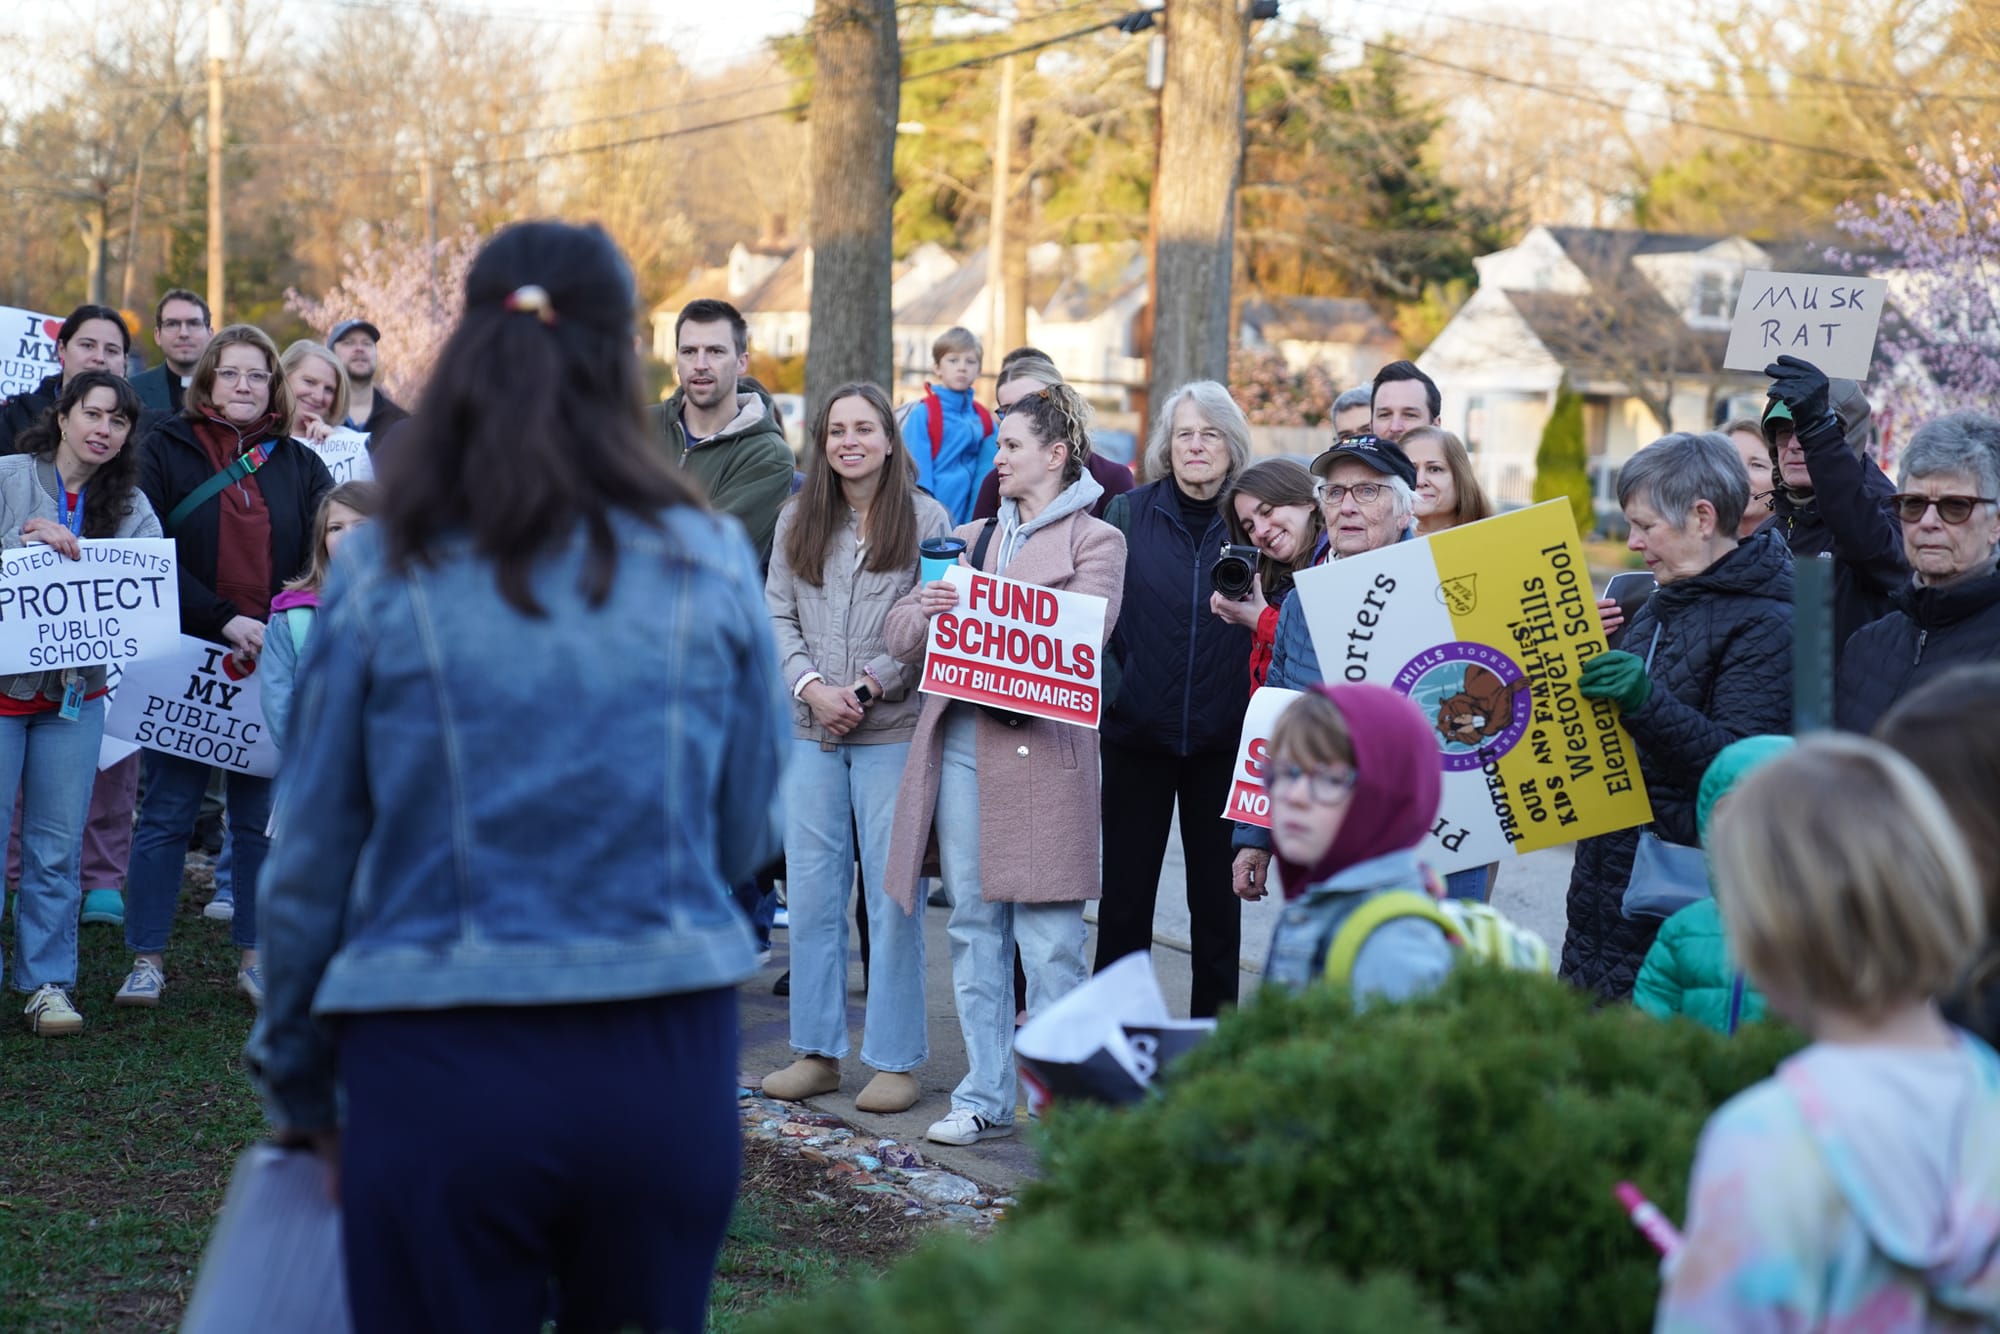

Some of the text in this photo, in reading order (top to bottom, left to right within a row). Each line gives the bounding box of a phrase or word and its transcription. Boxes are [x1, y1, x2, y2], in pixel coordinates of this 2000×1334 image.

[1752, 286, 1865, 311] MUSK
[24, 316, 42, 338] I
[1760, 319, 1841, 348] RAT
[71, 547, 171, 573] TUDENTS
[0, 577, 166, 622] PROTECT
[969, 574, 1059, 627] FUND
[1541, 541, 1590, 637] School
[38, 617, 121, 644] PUBLIC
[935, 612, 1095, 680] SCHOOLS
[29, 638, 138, 667] SCHOOLS
[198, 647, 223, 675] I
[1400, 649, 1445, 685] HILLS
[183, 674, 242, 711] MY
[931, 661, 1093, 713] NOT BILLIONAIRES
[1520, 576, 1594, 782] Westover Hills
[142, 695, 261, 744] PUBLIC
[135, 720, 250, 769] SCHOOL
[1531, 729, 1553, 764] AND
[1237, 790, 1271, 816] NO
[1478, 747, 1526, 844] PROTECT
[1519, 778, 1547, 823] OUR
[1546, 775, 1579, 827] KIDS
